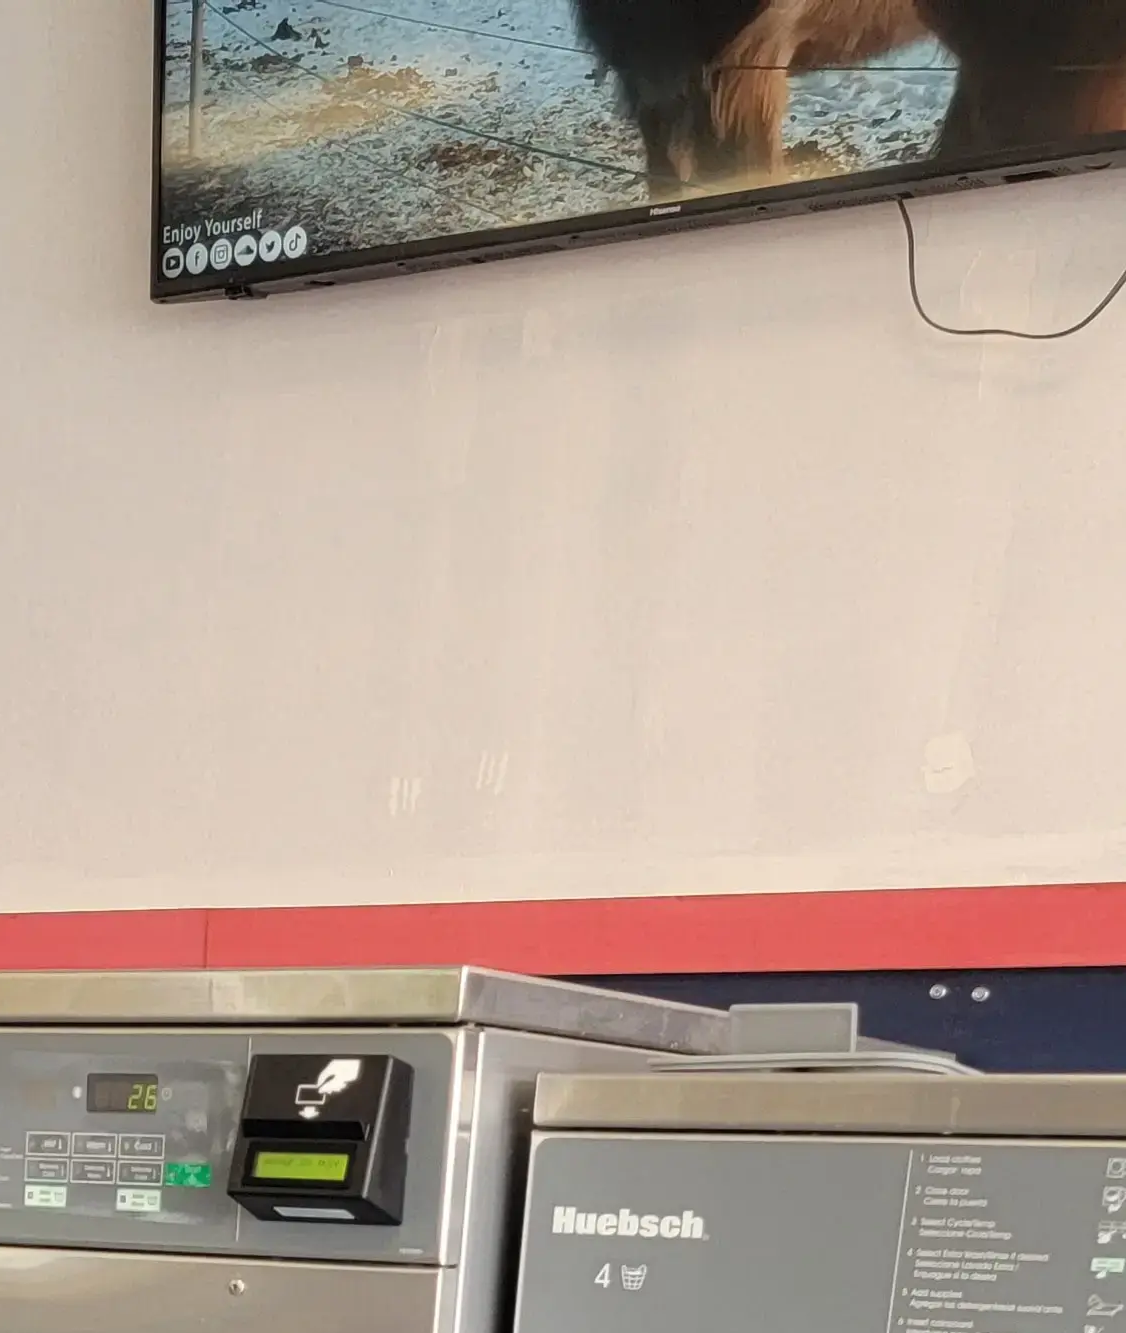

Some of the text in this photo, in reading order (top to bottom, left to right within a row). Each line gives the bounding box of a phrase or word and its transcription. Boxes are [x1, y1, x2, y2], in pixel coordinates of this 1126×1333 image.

[163, 208, 264, 246] Enjoy Yourself
[127, 1084, 158, 1110] 26
[552, 1206, 704, 1239] Huebsch
[593, 1263, 611, 1288] 4
